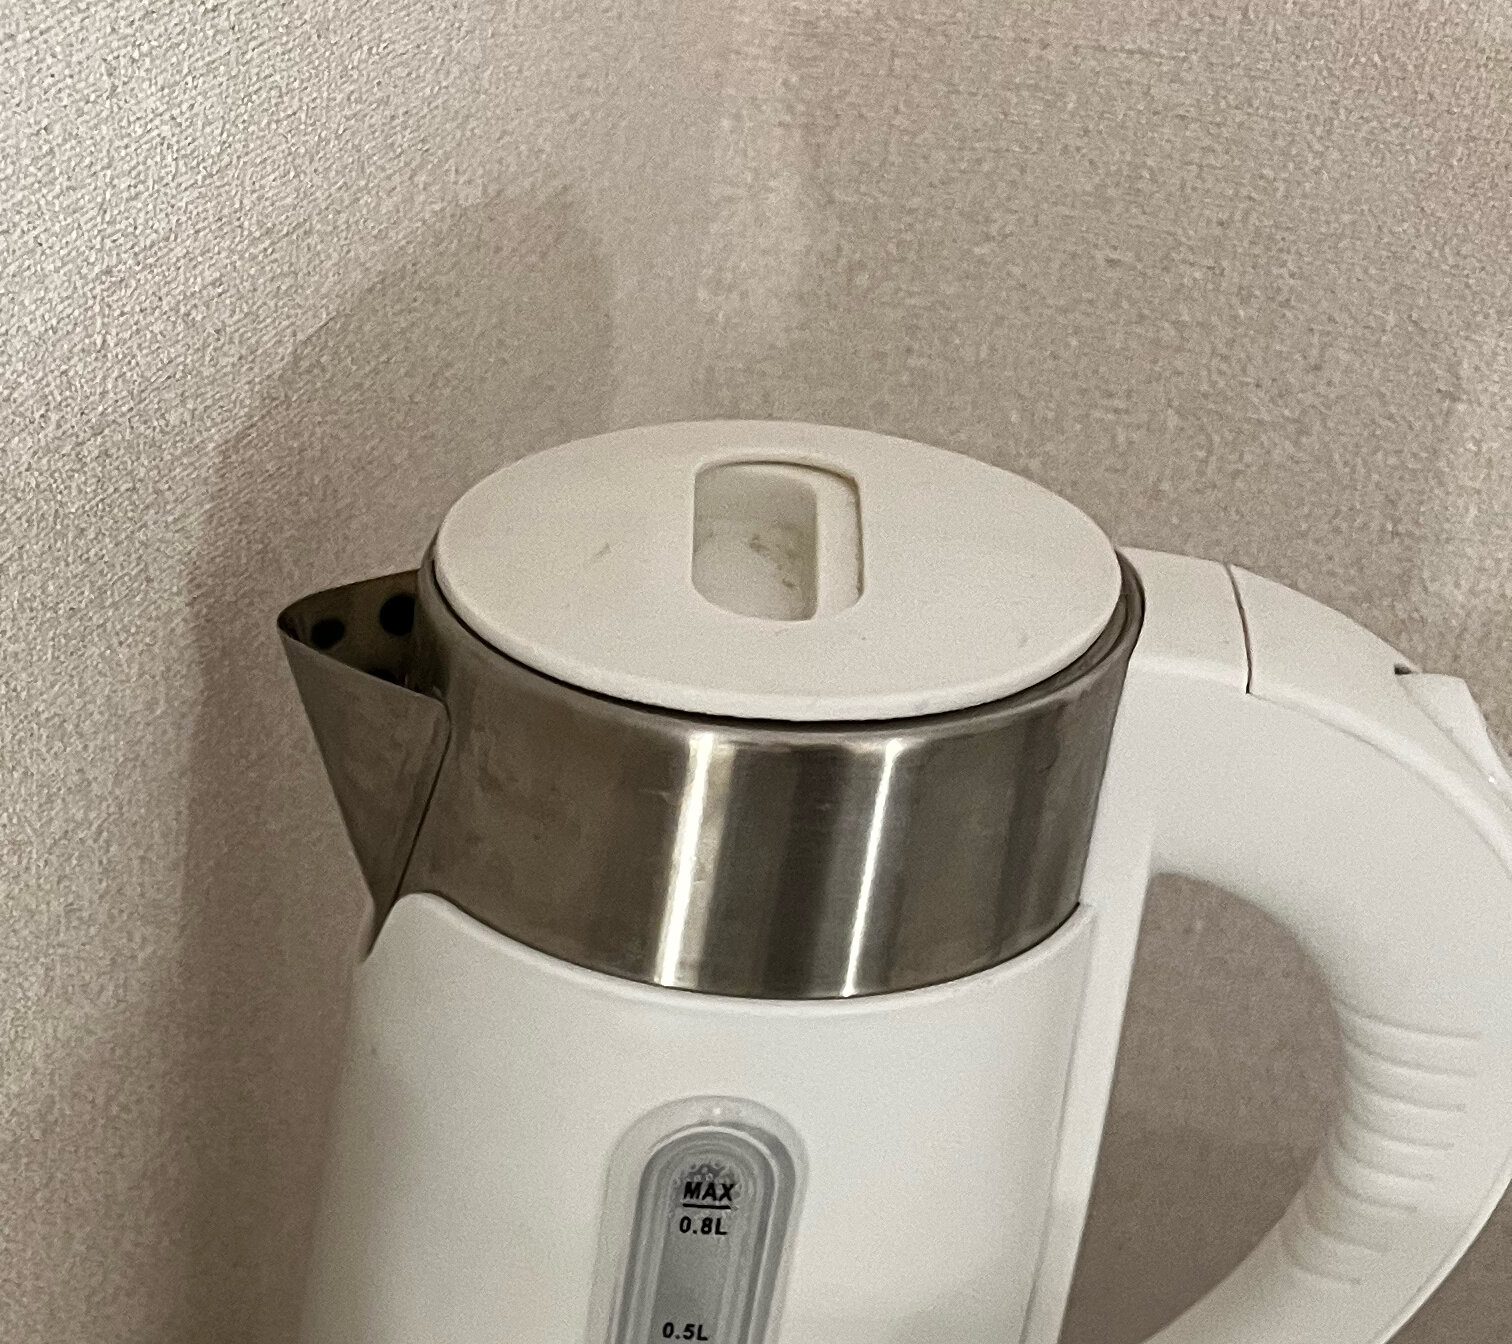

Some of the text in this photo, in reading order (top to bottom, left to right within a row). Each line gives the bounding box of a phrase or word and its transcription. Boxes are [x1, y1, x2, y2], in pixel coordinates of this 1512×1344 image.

[683, 1181, 735, 1202] MAX
[679, 1216, 728, 1236] 0.8L
[661, 1321, 709, 1342] 0.5L
